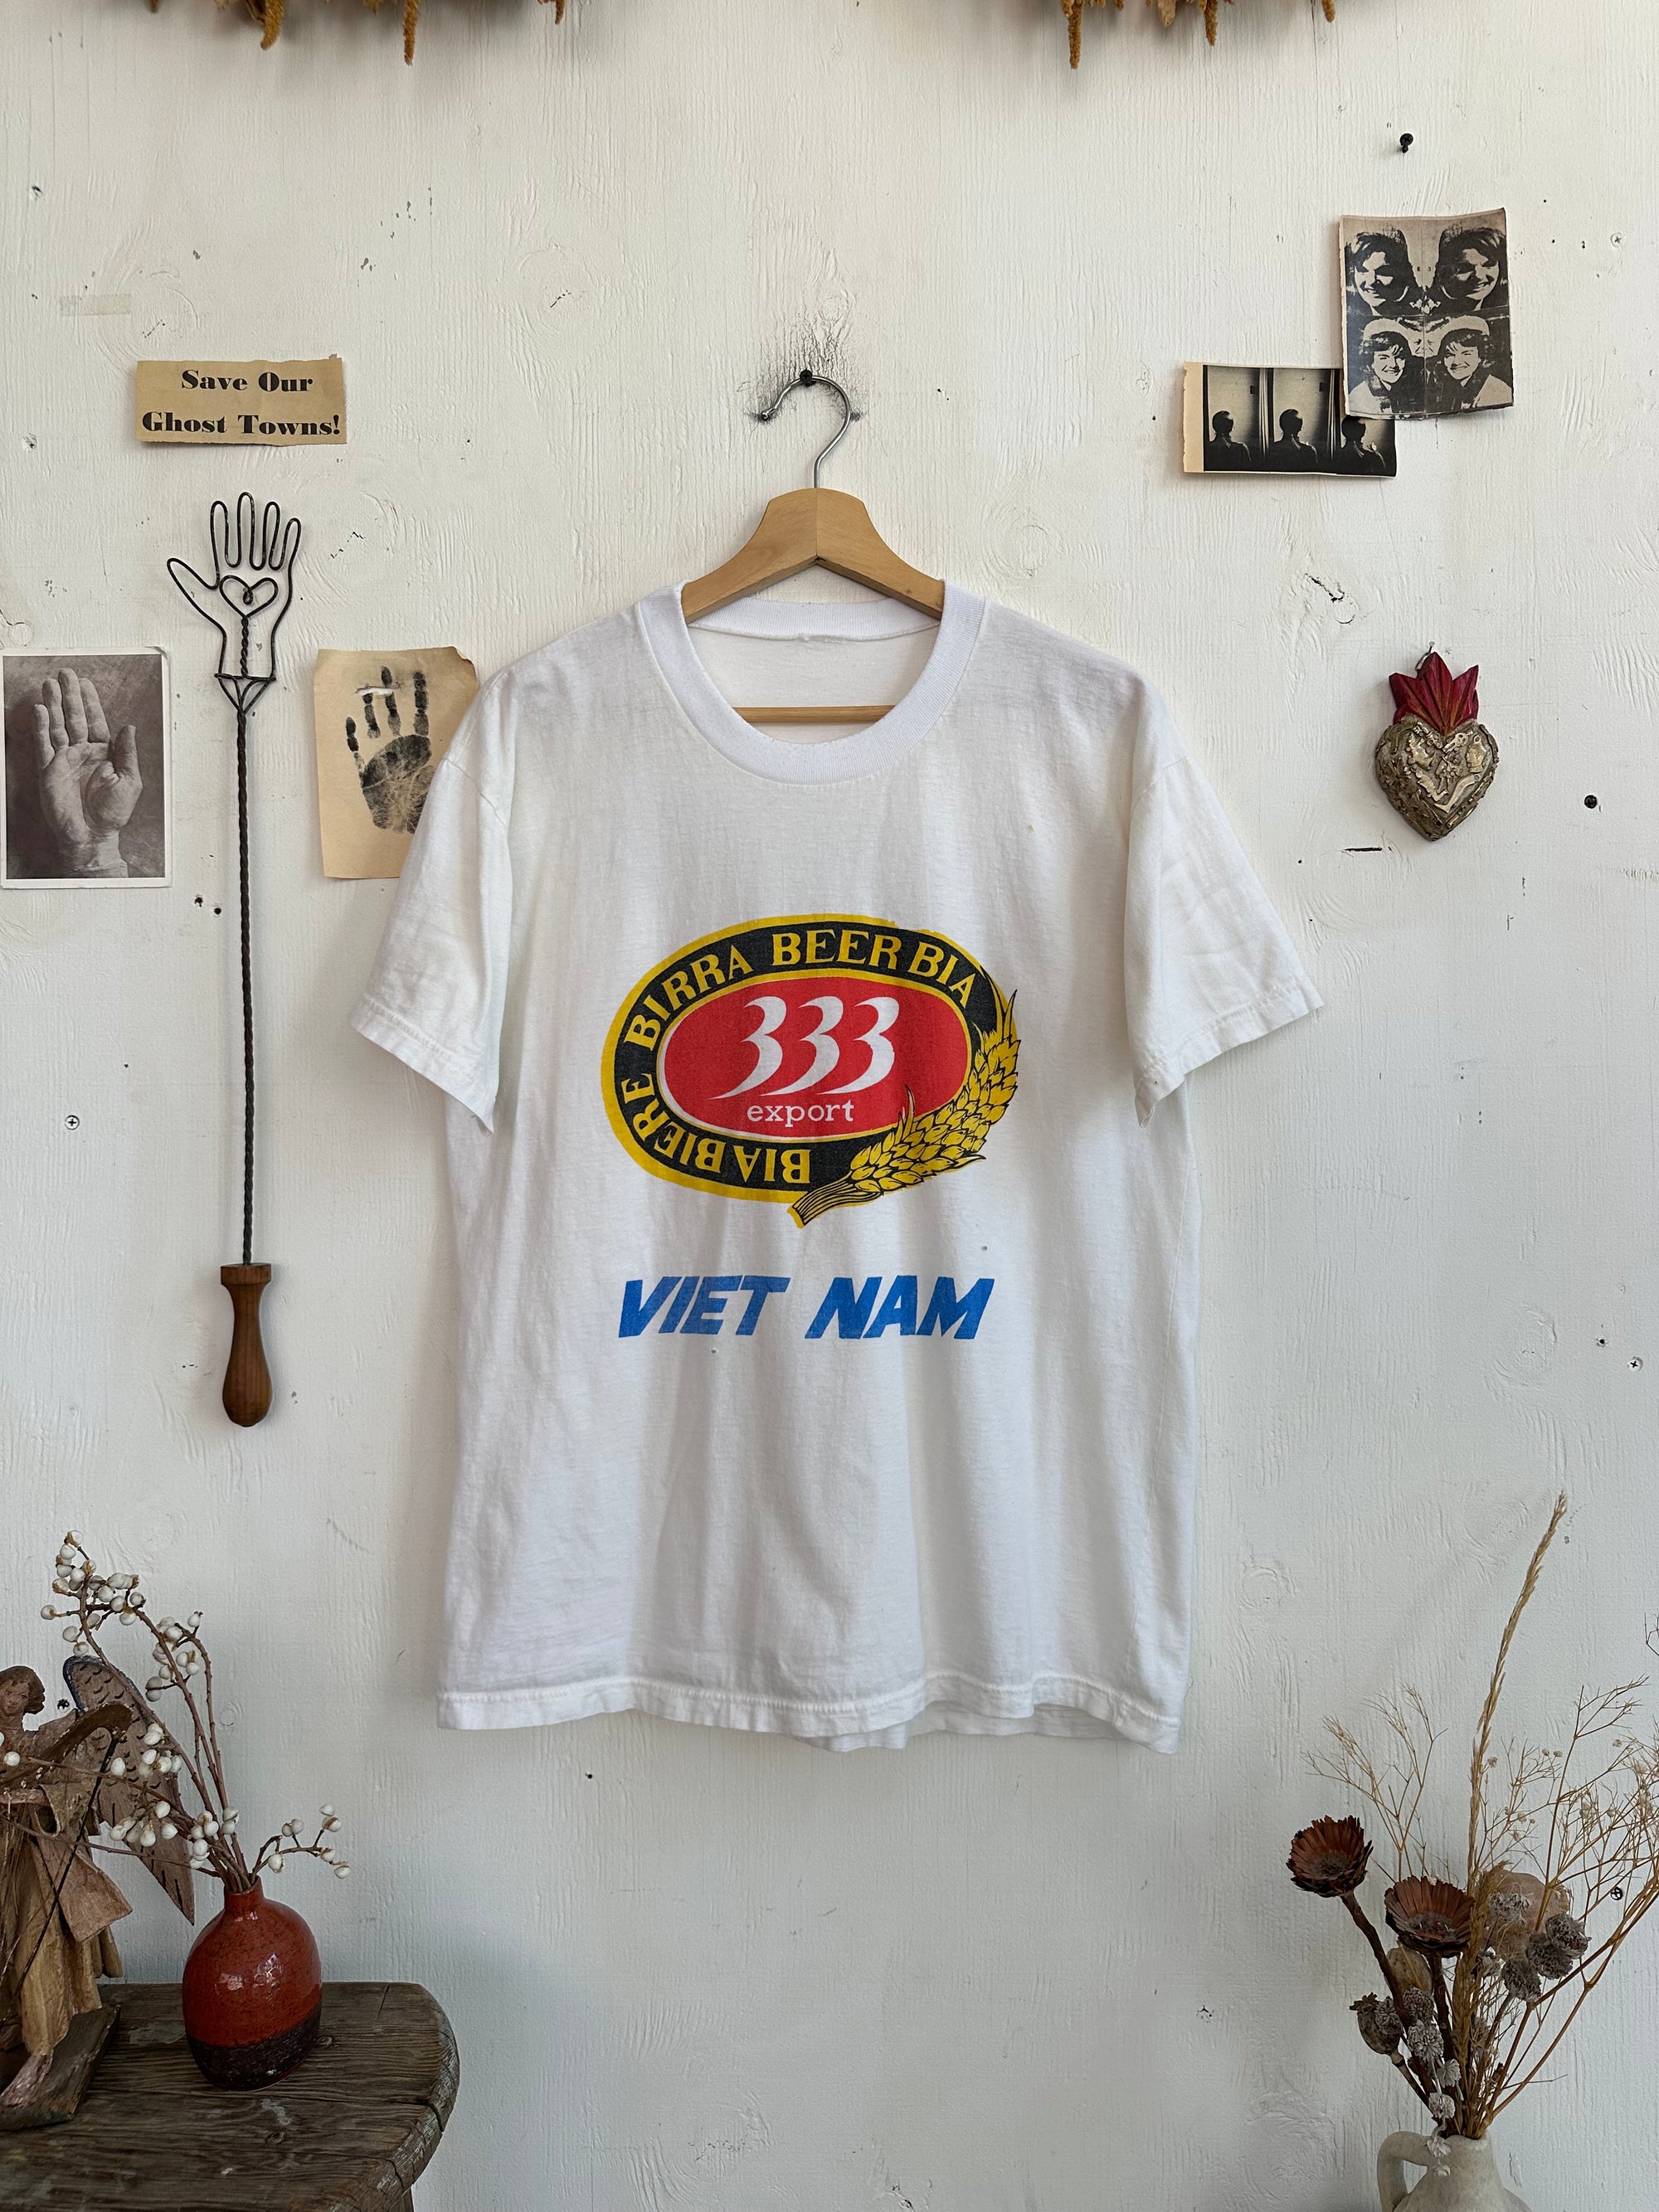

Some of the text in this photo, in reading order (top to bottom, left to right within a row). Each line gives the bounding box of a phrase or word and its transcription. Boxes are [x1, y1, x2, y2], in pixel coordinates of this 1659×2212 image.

[181, 370, 313, 391] Save Our
[142, 411, 340, 435] Ghost Towns!
[622, 929, 980, 1184] BIA BIERE BIRRA BEER BIA
[709, 996, 900, 1100] 333
[747, 1099, 854, 1127] export
[618, 1275, 995, 1339] VIET NAM
